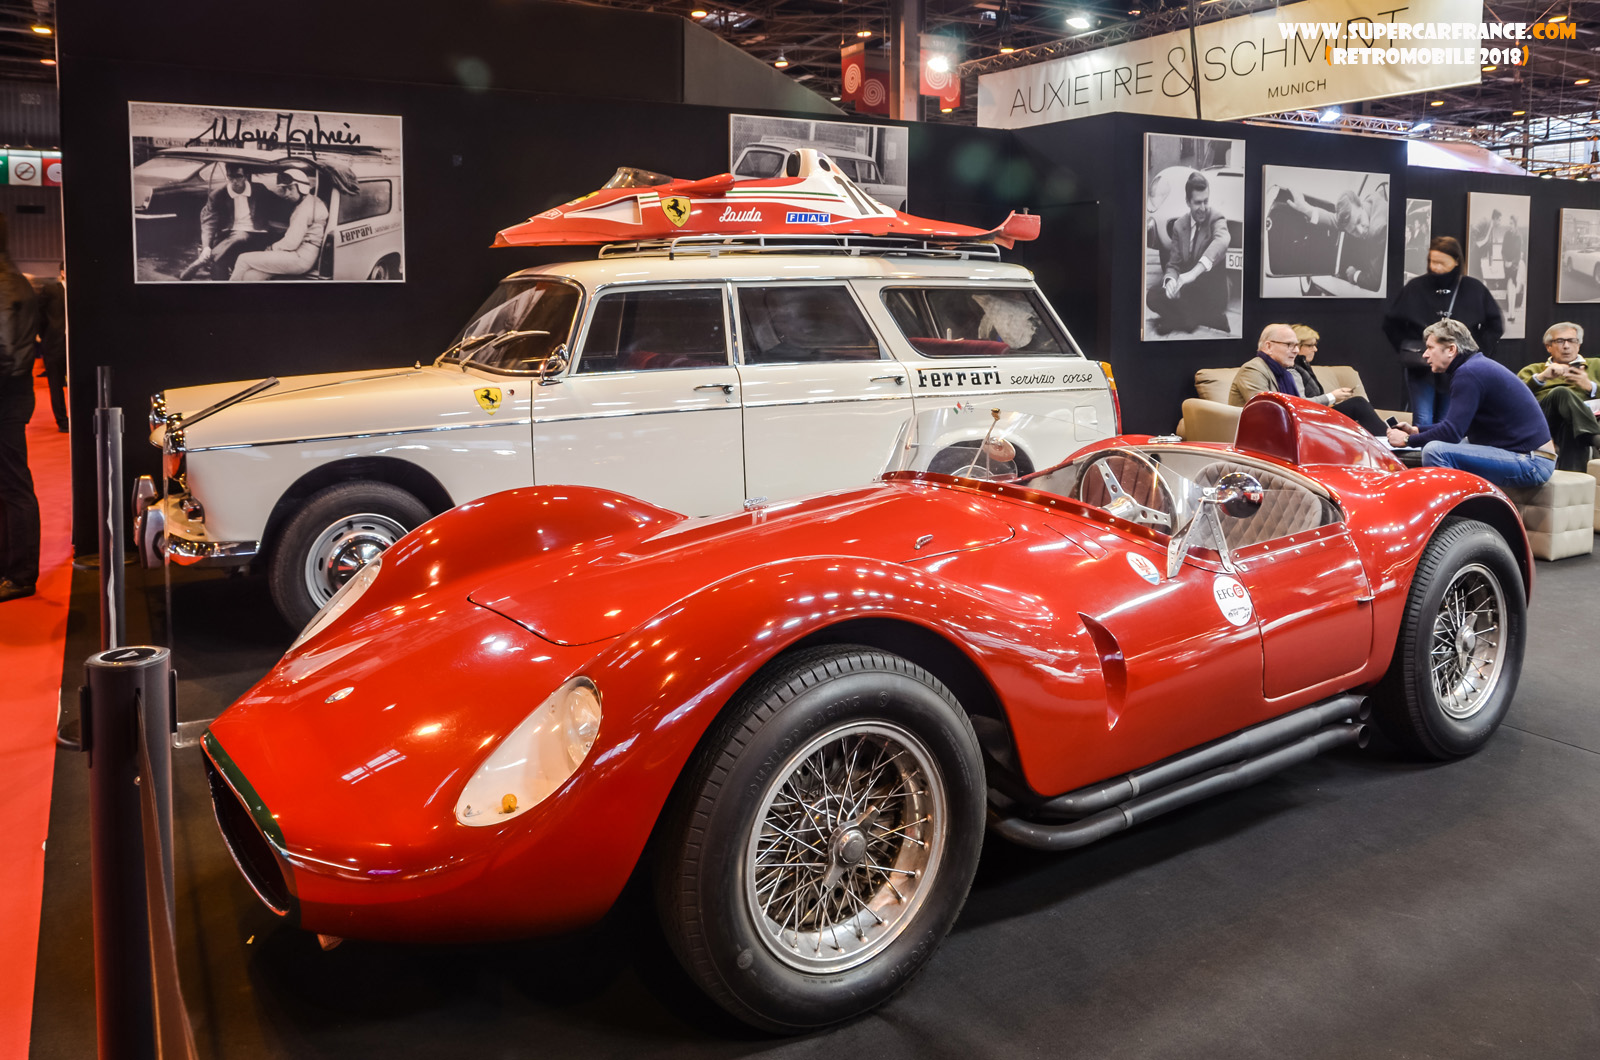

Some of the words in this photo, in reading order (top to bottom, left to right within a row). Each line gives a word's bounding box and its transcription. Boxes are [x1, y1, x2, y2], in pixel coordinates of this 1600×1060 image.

[1009, 60, 1154, 117] AUXIETRE
[1161, 46, 1196, 98] &
[1267, 78, 1327, 98] MUNICH
[719, 206, 763, 223] Lauda
[787, 212, 830, 223] FIAT
[339, 224, 373, 243] Ferrari
[916, 366, 1002, 388] Ferrari
[1010, 373, 1056, 385] servizio
[1062, 372, 1093, 383] corse
[1216, 587, 1235, 600] EFG
